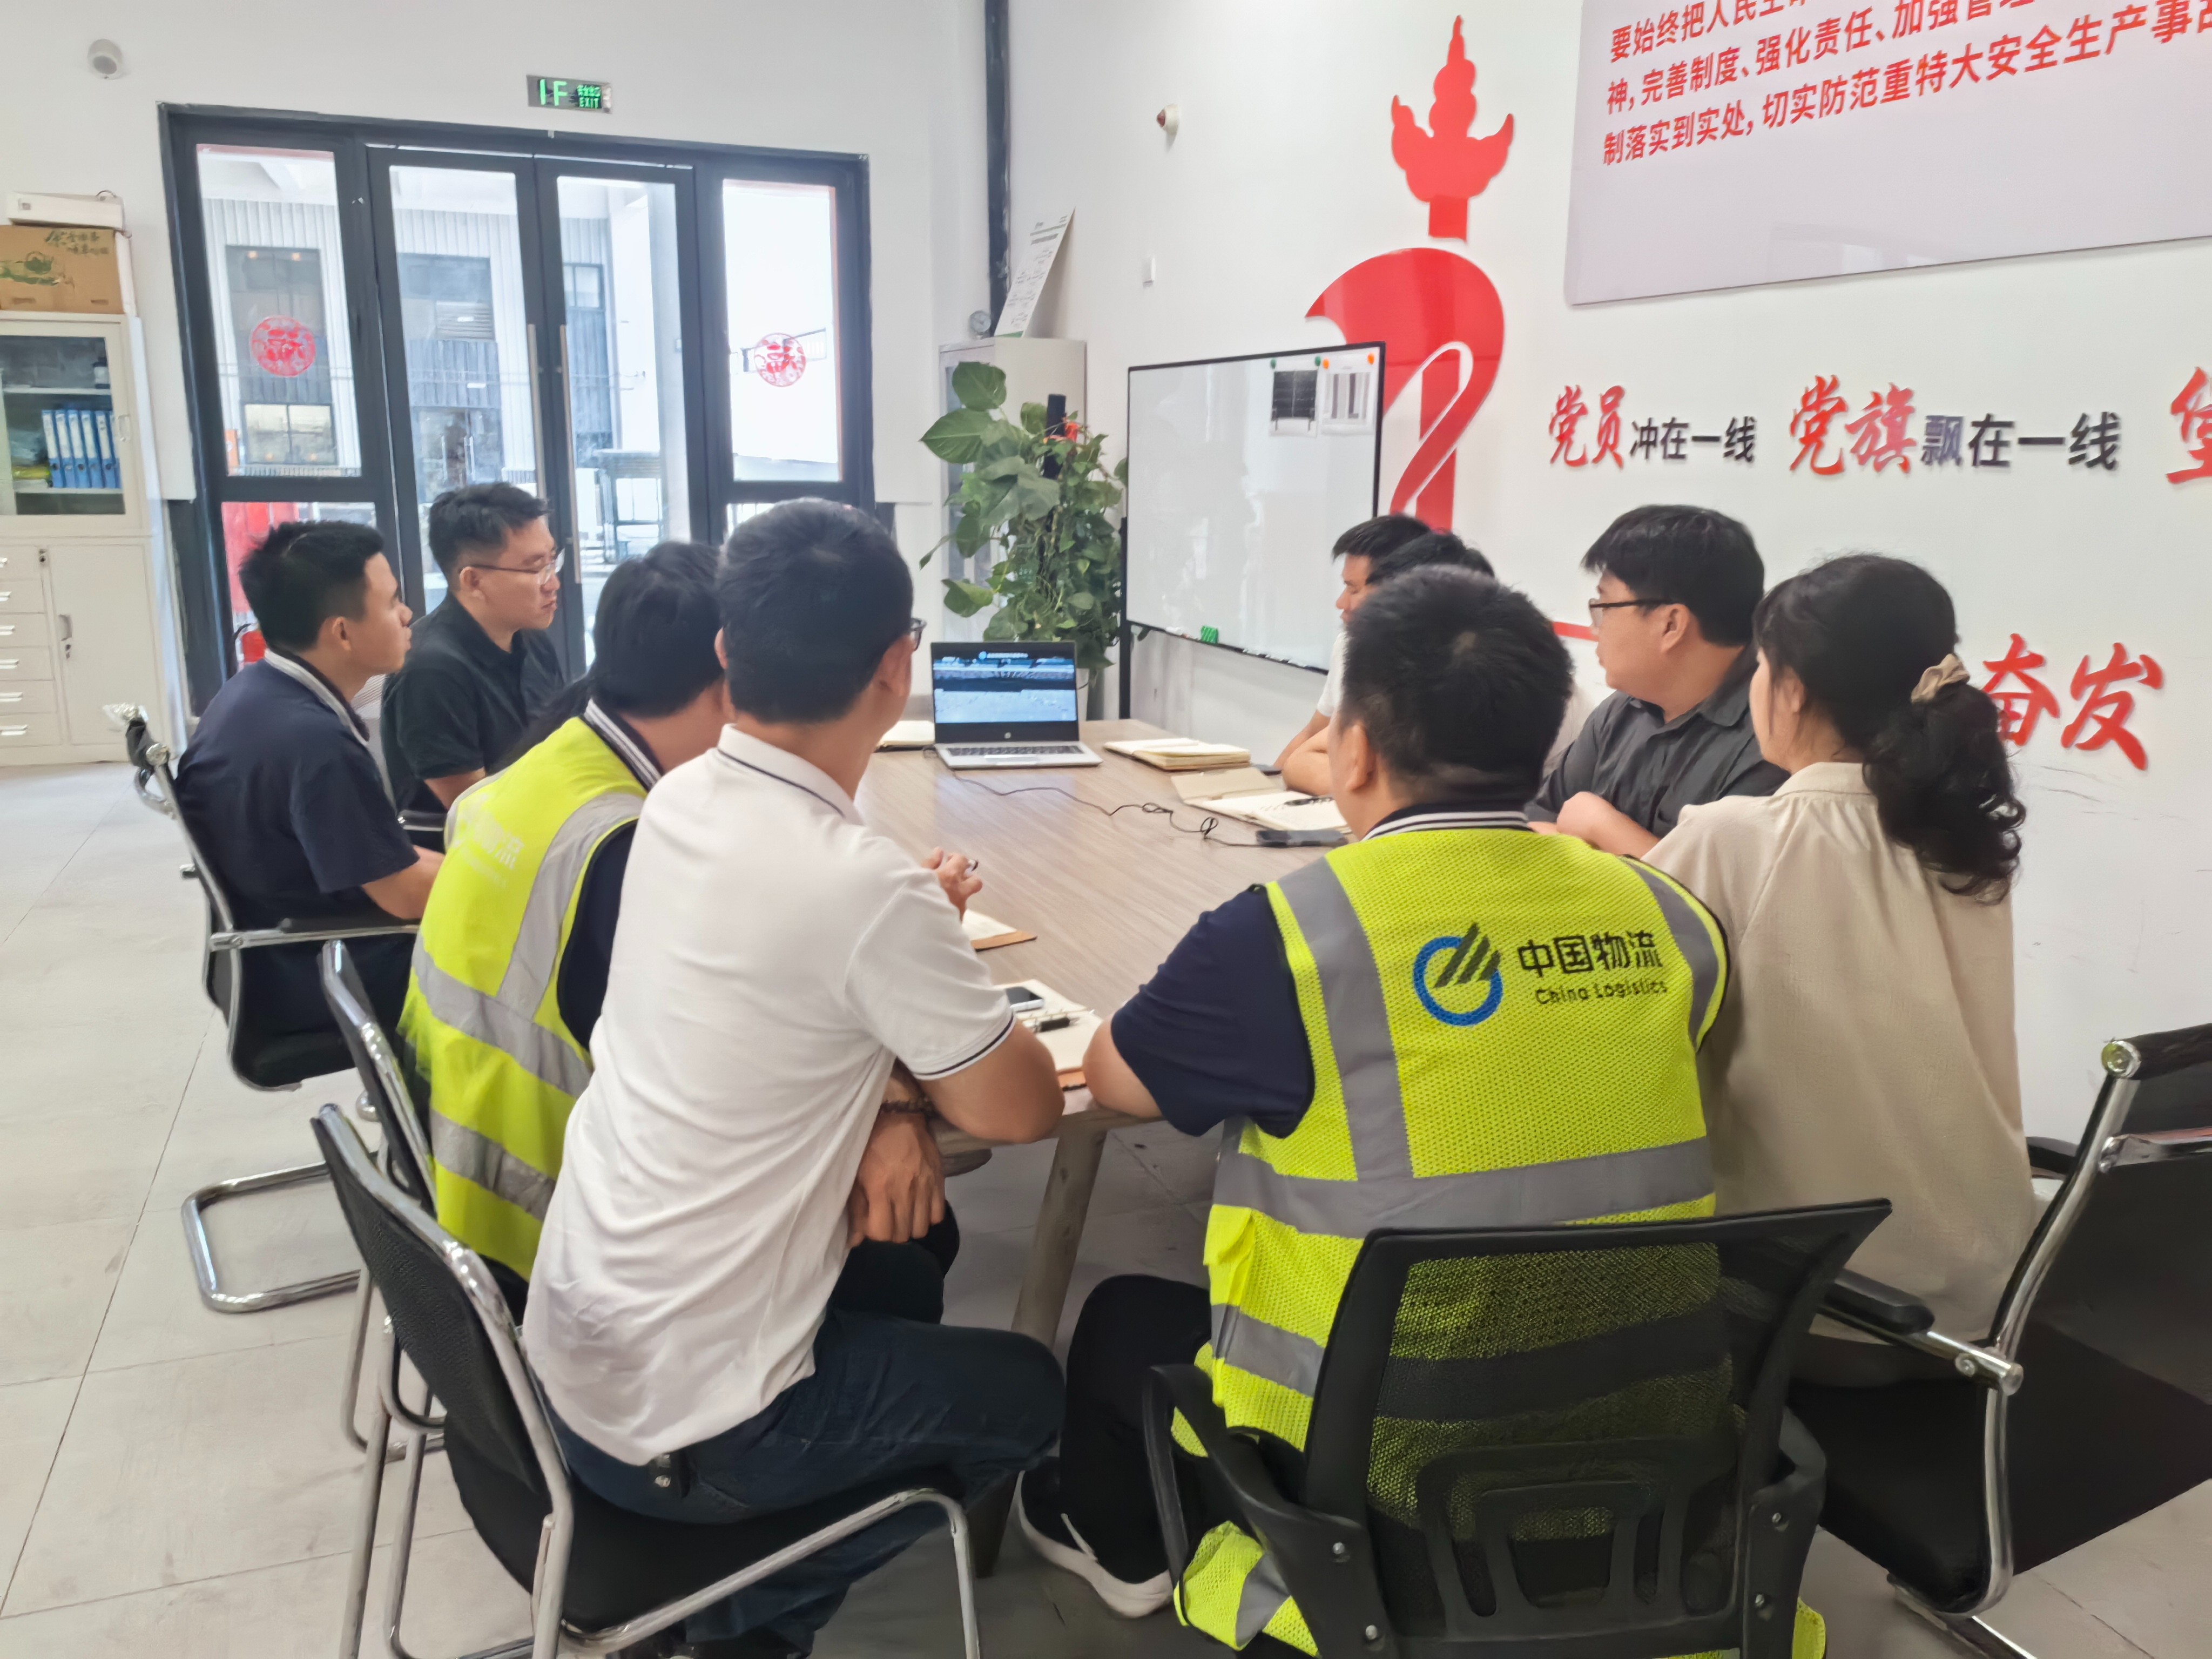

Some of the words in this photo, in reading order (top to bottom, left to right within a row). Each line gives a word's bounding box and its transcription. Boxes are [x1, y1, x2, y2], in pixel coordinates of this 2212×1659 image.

[1607, 0, 2035, 114] 神,完善制度、强化责任、加强
[1610, 0, 1806, 63] 要始终把人民
[1549, 385, 1756, 470] 党员冲在一线
[1789, 375, 2121, 475] 党旗飘在一线
[1982, 633, 2164, 771] 奋发
[1516, 929, 1663, 978] 中国物流
[1535, 986, 1589, 1005] China
[1593, 978, 1668, 999] Logistics
